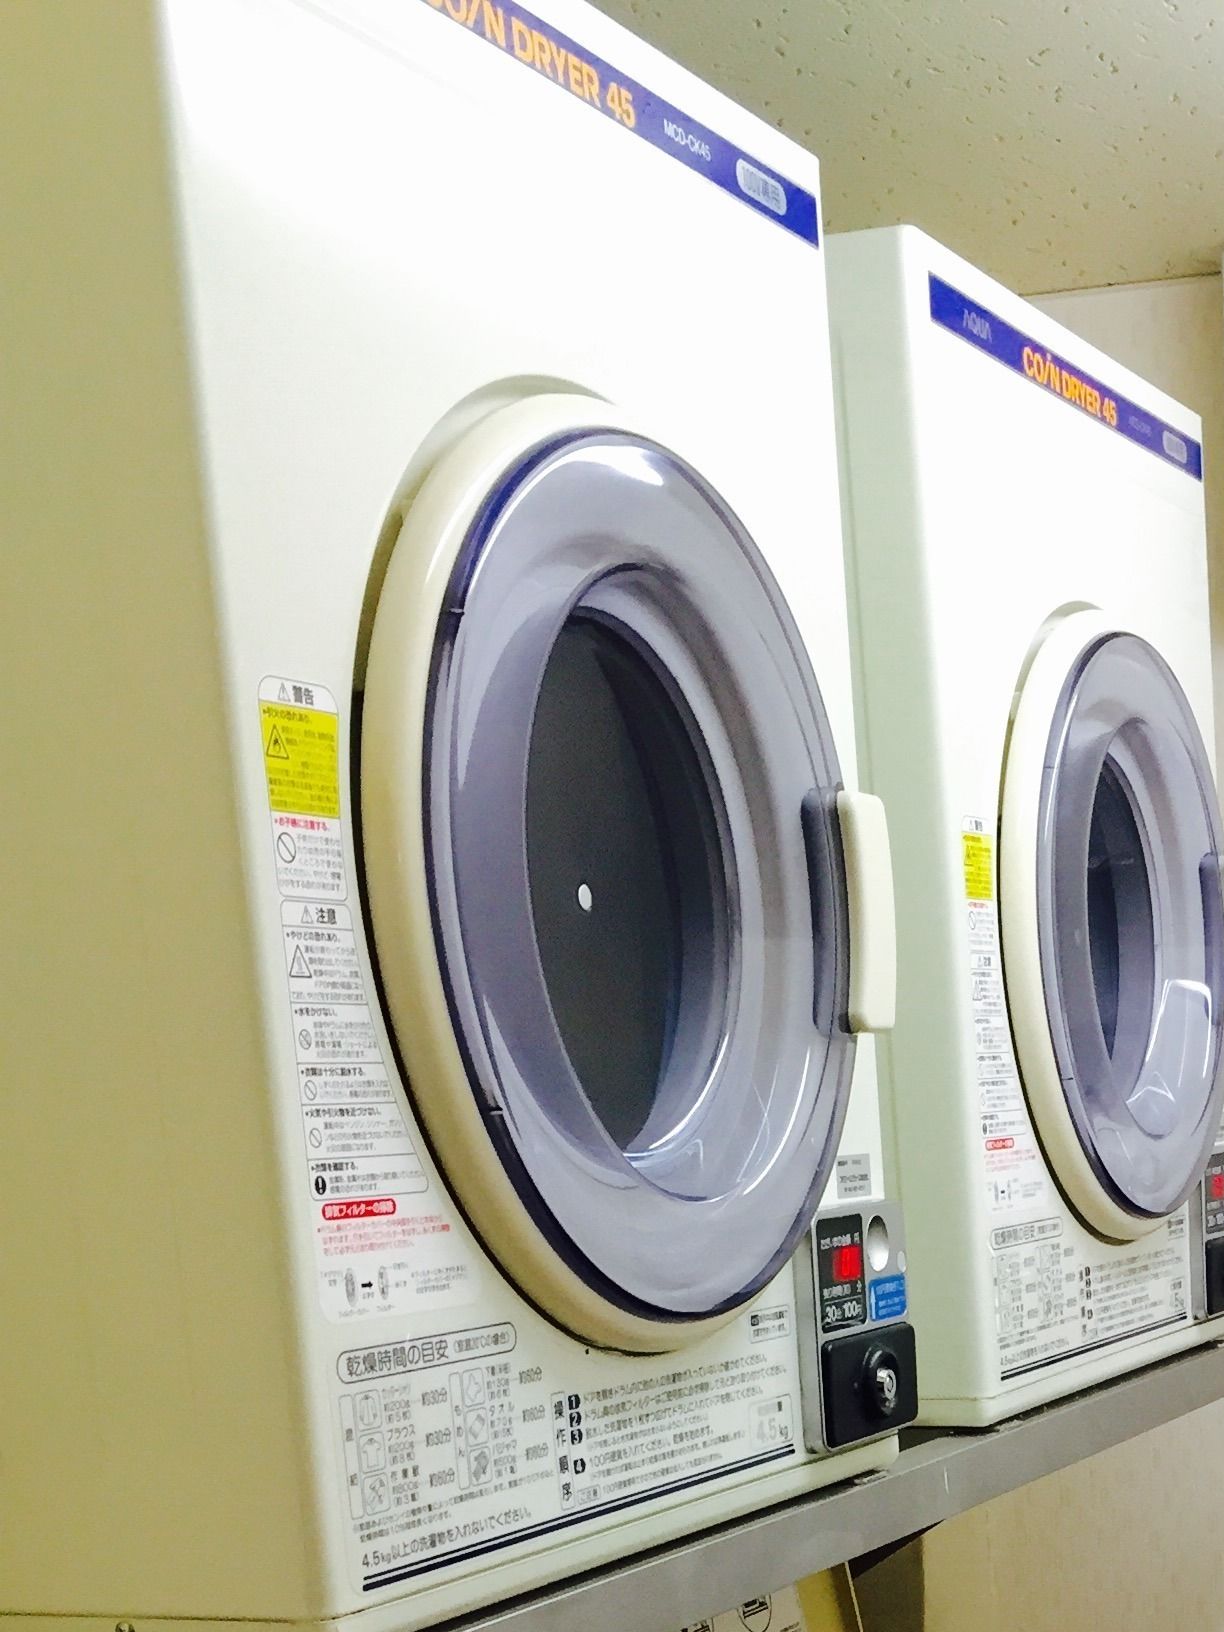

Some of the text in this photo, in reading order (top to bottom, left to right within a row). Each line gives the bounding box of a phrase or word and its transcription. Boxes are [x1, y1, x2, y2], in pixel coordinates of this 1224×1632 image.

[424, 0, 637, 128] OIN DRYER 45
[663, 119, 712, 162] MCD-CK45
[962, 309, 994, 344] AQUA
[1062, 370, 1102, 417] DRYER
[1103, 397, 1118, 427] 45
[291, 684, 314, 706] 警告
[315, 906, 337, 925] 注意
[346, 1340, 450, 1378] 乾燥時間の目安
